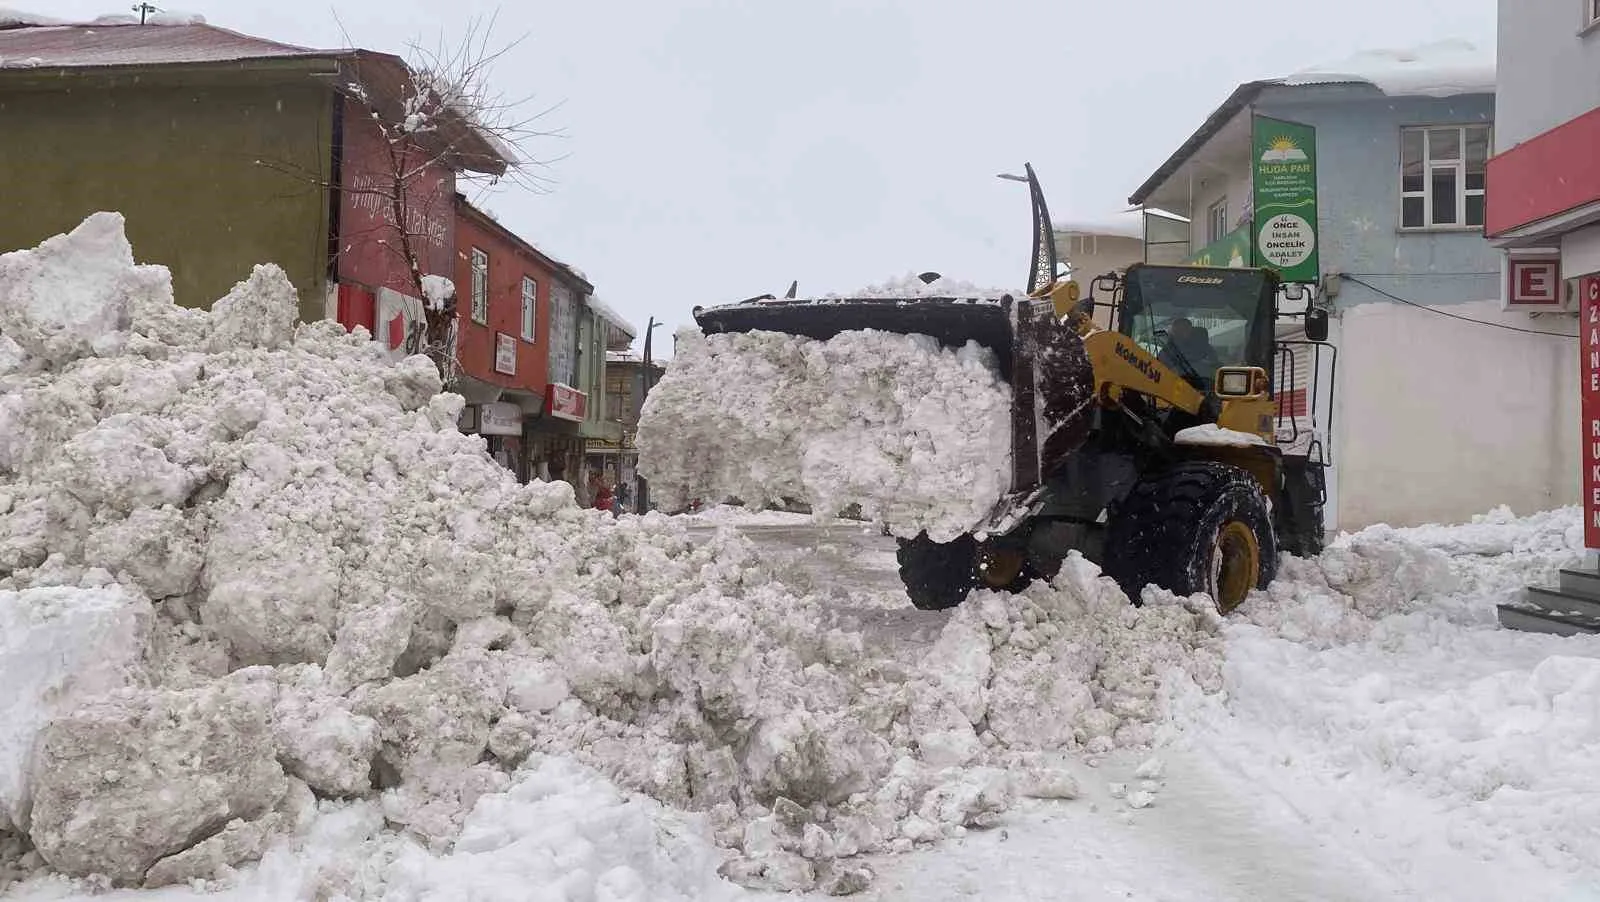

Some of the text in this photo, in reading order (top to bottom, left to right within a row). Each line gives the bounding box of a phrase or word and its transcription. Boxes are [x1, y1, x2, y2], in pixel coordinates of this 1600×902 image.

[1290, 163, 1311, 173] PAR
[1520, 267, 1548, 297] E
[1115, 342, 1161, 384] KOMATSU
